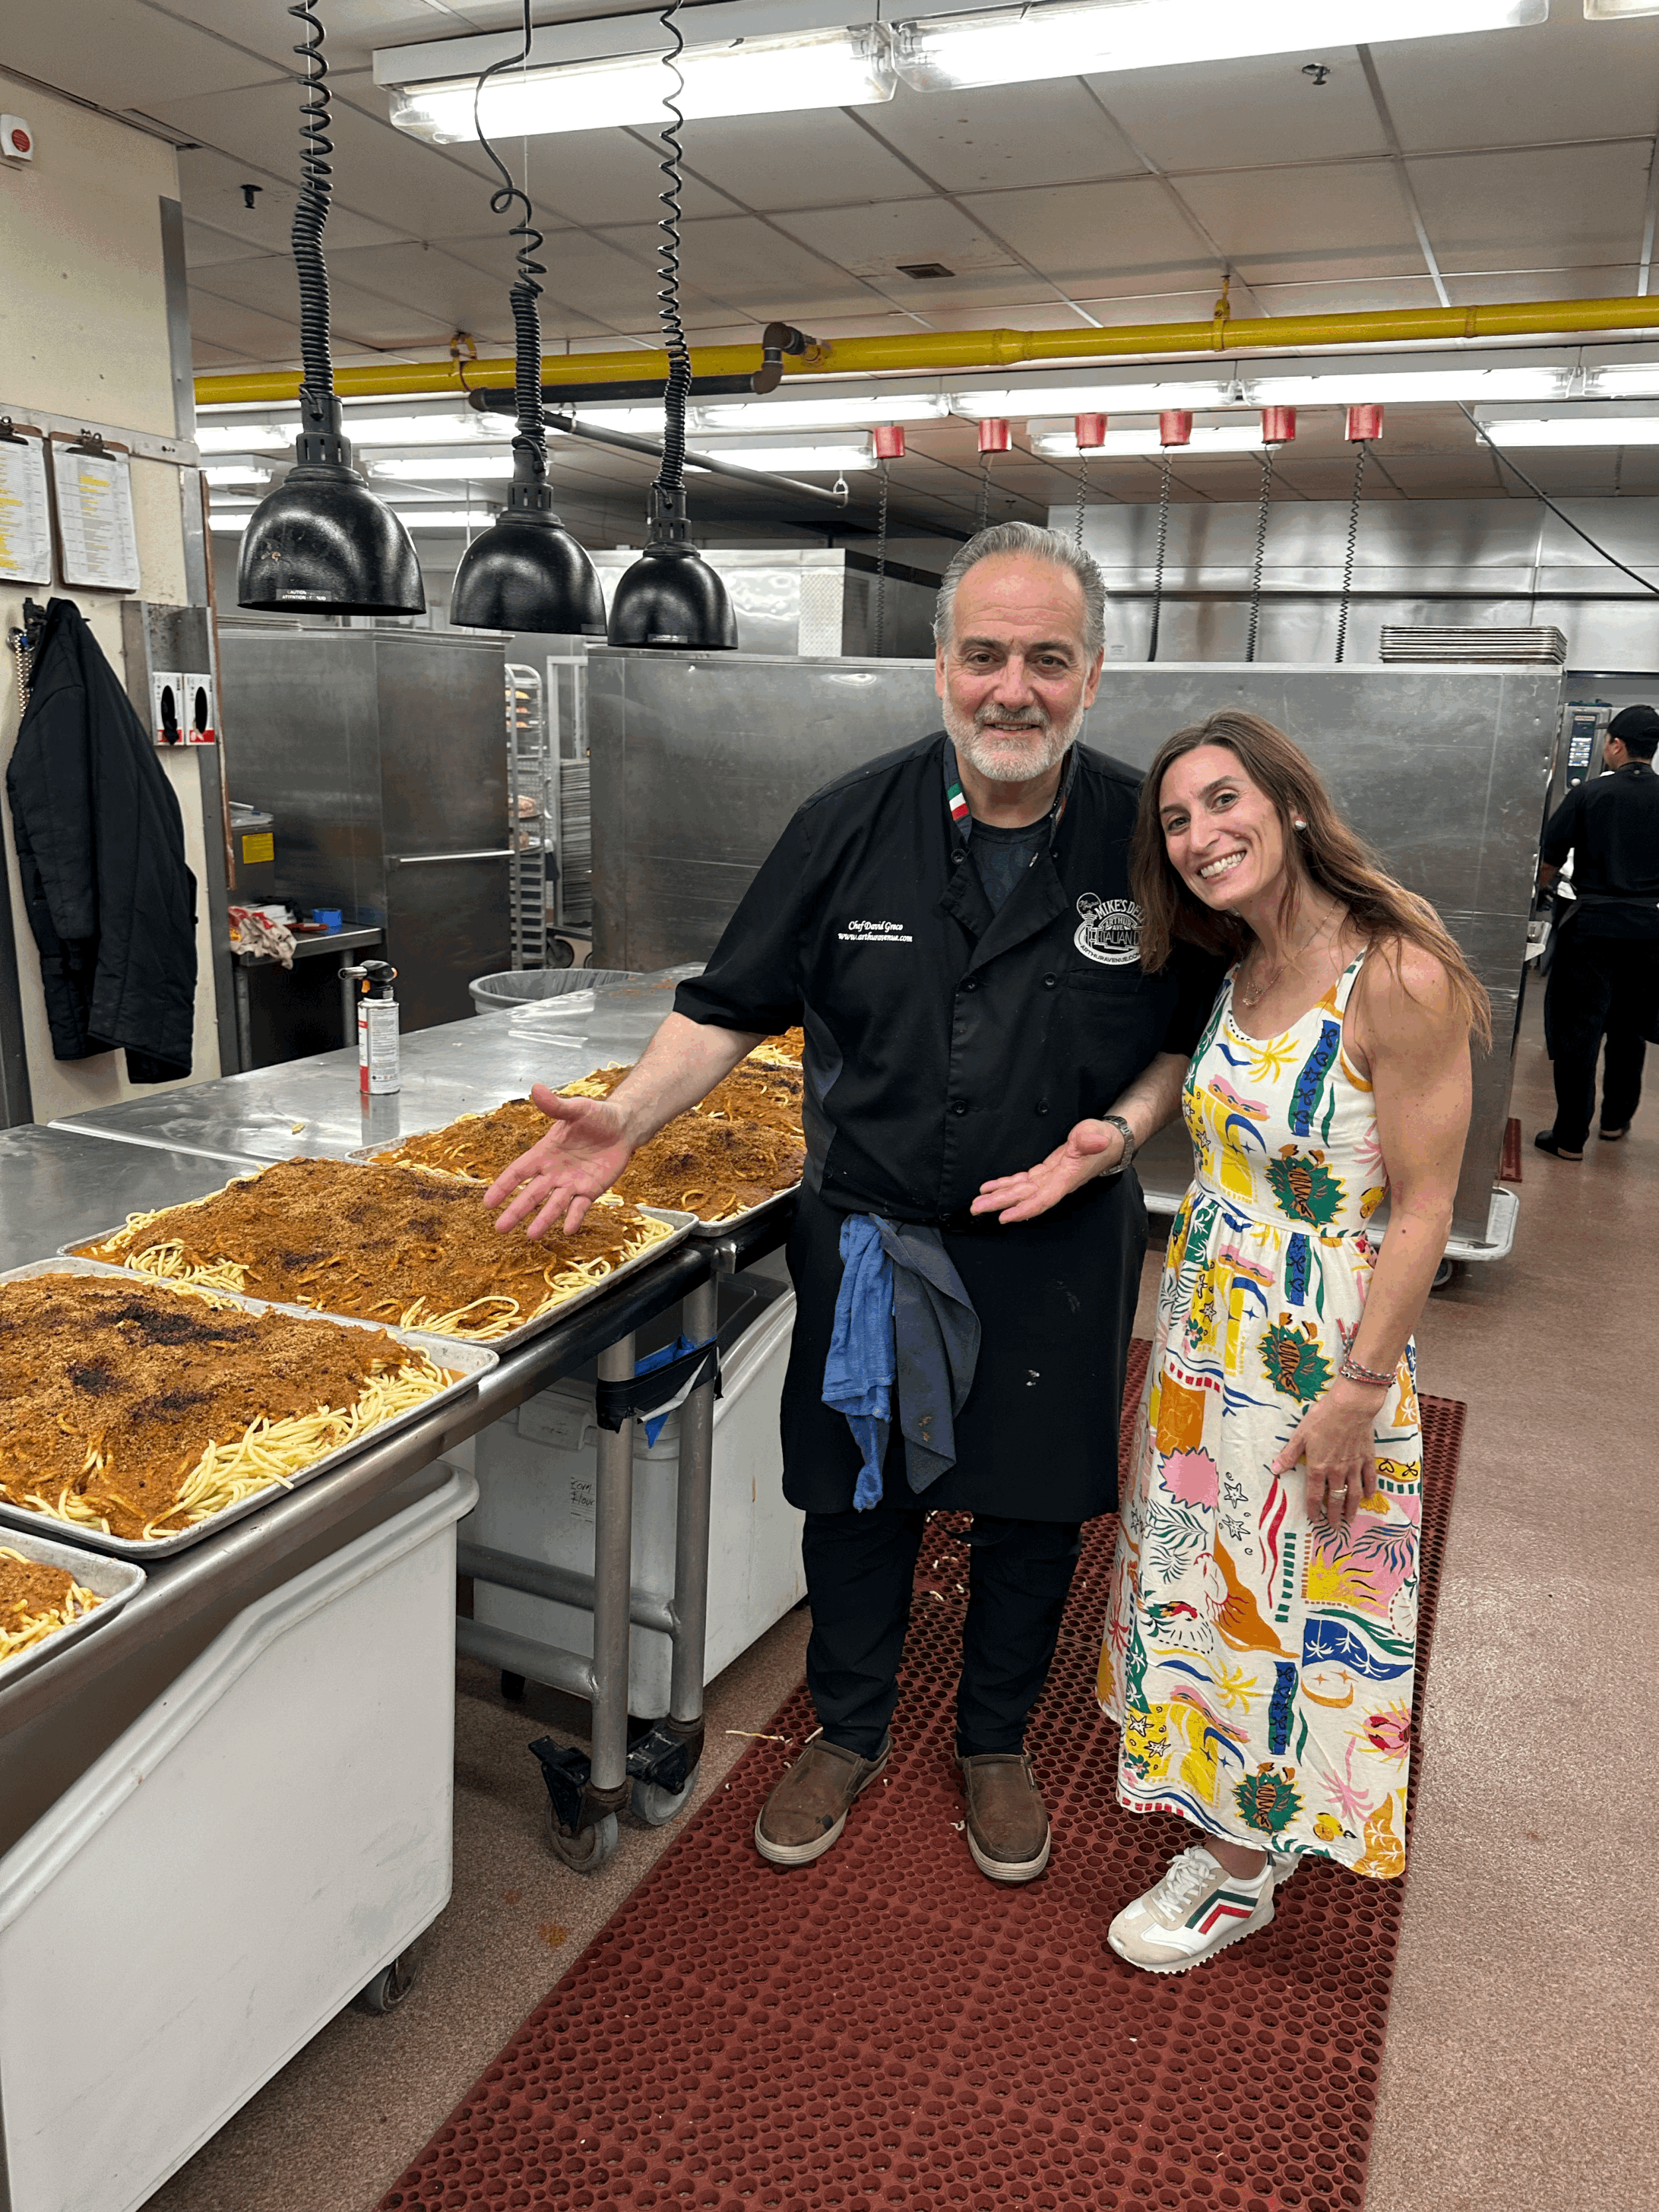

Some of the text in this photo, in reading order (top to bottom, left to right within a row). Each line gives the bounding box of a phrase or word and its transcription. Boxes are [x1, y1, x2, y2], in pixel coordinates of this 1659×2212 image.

[1094, 899, 1128, 920] MIKE'S
[848, 921, 903, 932] Chef David Greco
[1105, 917, 1131, 929] ARTHUR
